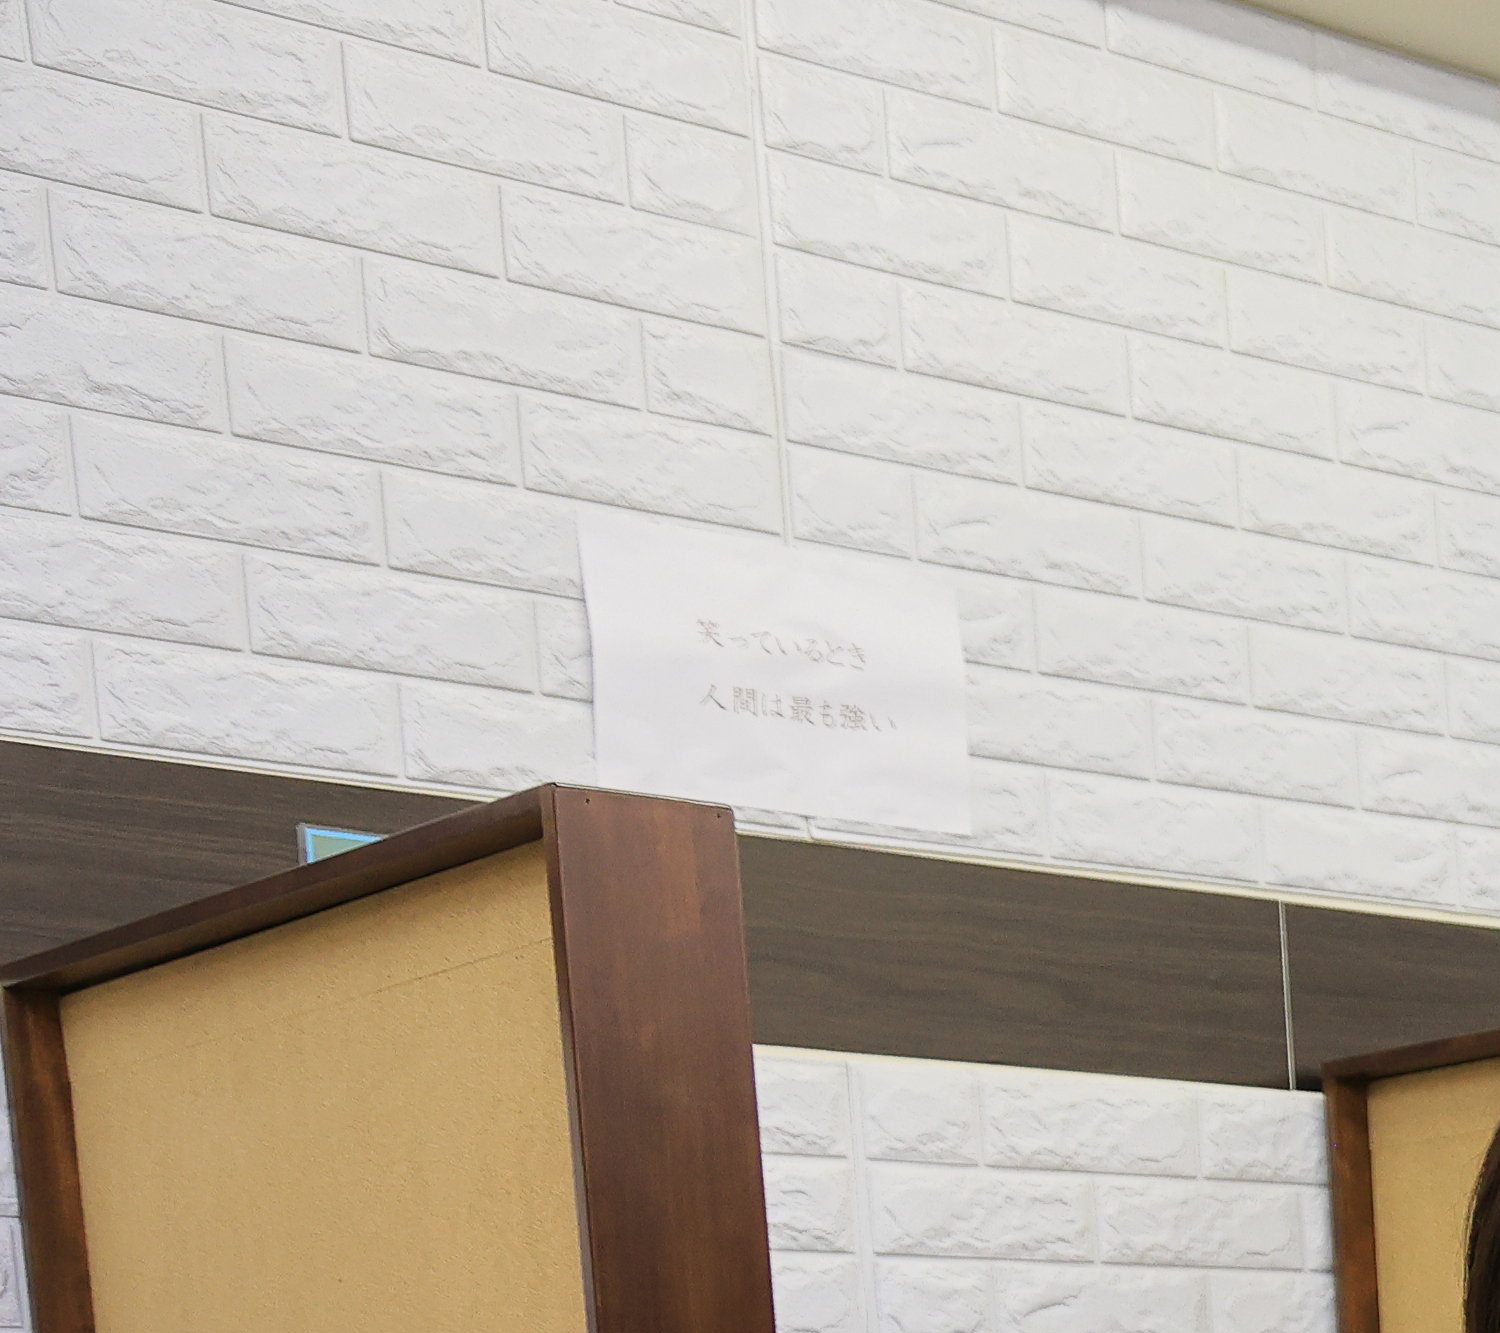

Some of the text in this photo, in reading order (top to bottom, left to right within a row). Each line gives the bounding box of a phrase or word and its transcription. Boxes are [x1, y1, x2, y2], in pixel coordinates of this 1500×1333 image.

[696, 618, 866, 671] 笑っているとき
[699, 683, 897, 732] 人間は最も強い
